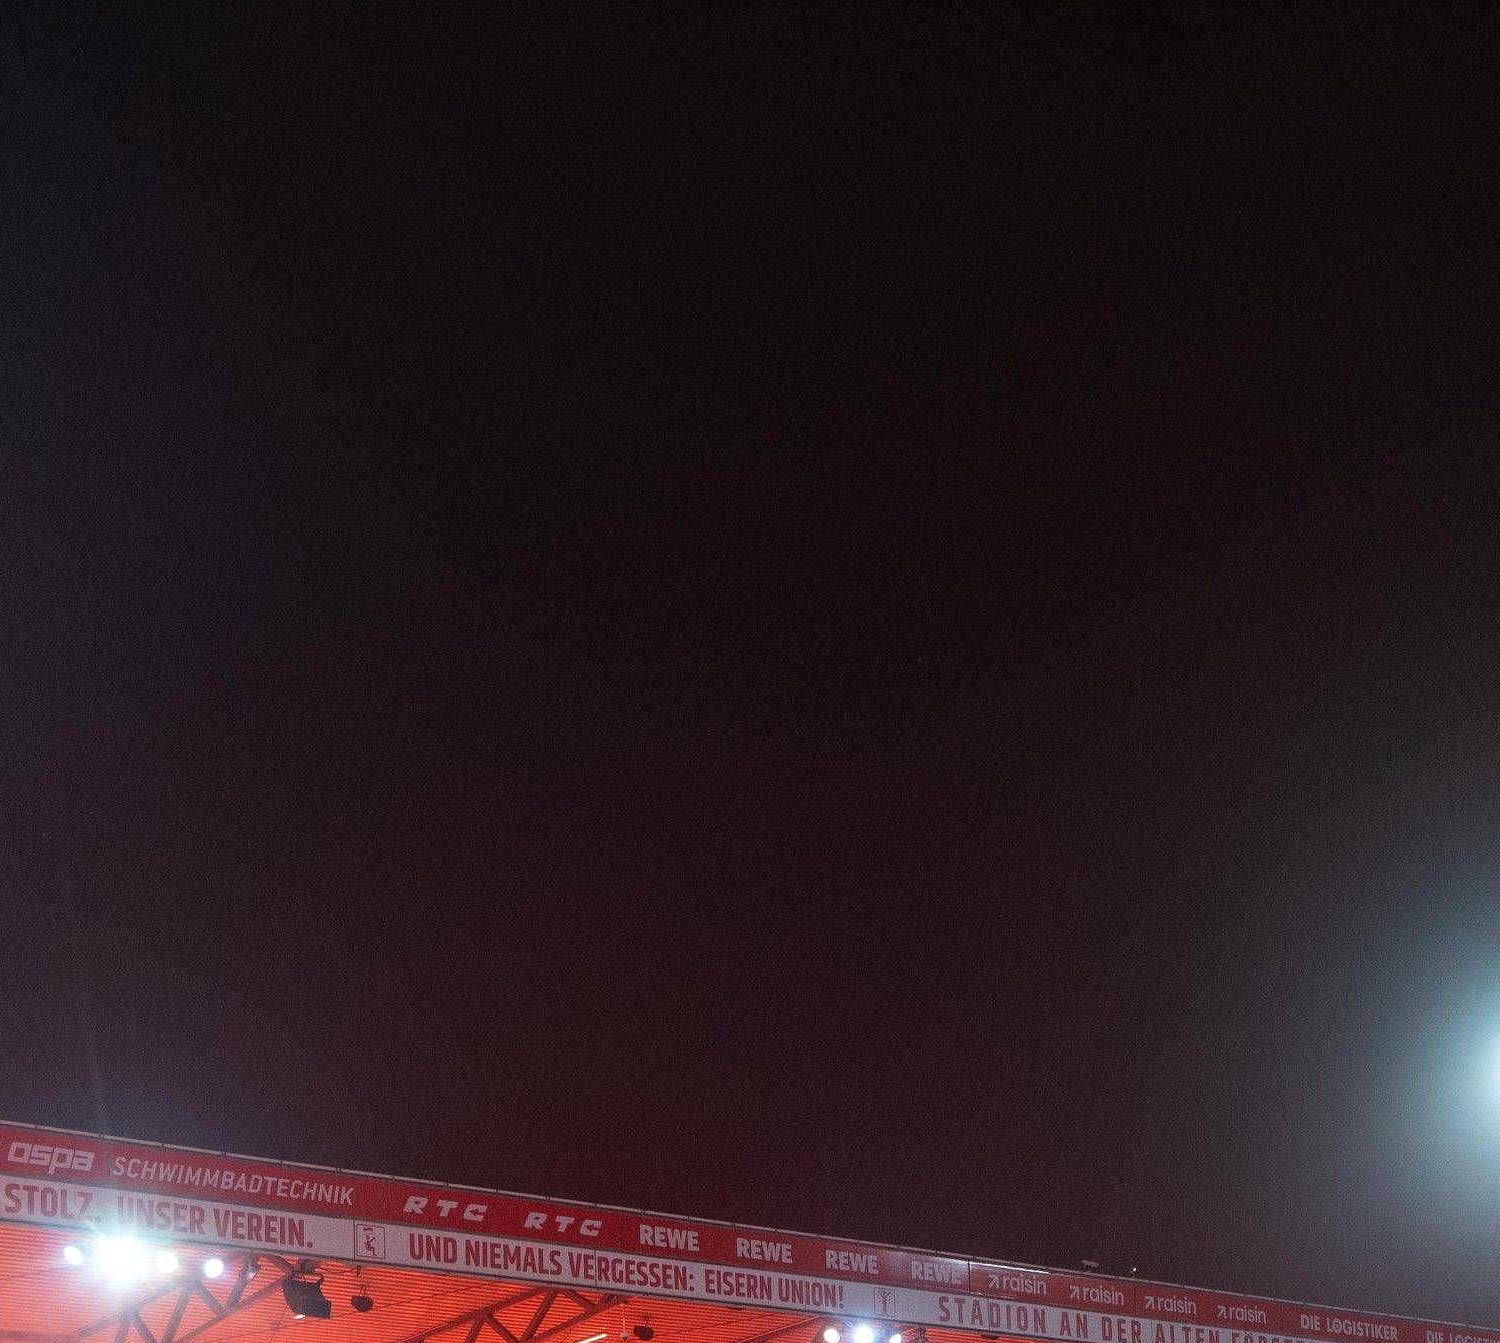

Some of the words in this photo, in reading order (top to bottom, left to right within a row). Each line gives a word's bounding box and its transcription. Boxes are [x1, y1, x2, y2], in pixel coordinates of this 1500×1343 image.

[112, 1156, 357, 1207] SCHWIMMBADTECHNIK
[4, 1182, 100, 1224] STOLZ.
[116, 1195, 206, 1236] UNSER
[213, 1208, 315, 1249] VEREIN.
[403, 1195, 488, 1222] RTC
[524, 1212, 604, 1237] RTC
[639, 1223, 700, 1252] REWE
[736, 1236, 793, 1265] REWE
[824, 1248, 879, 1276] REWE
[409, 1232, 457, 1264] UND
[465, 1239, 563, 1277] NIEMALS
[568, 1252, 696, 1293] VERGESSEN:
[705, 1268, 772, 1299] EISERN
[778, 1277, 845, 1310] UNION!
[911, 1260, 964, 1286] REWE
[1002, 1272, 1048, 1295] raisin
[1082, 1284, 1125, 1307] raisin
[1155, 1295, 1198, 1316] raisin
[938, 1296, 1047, 1335] STADION
[1059, 1311, 1089, 1339] AN
[1228, 1305, 1267, 1324] raisin
[1300, 1314, 1321, 1332] DIE
[1326, 1317, 1399, 1342] LOGISTIKER
